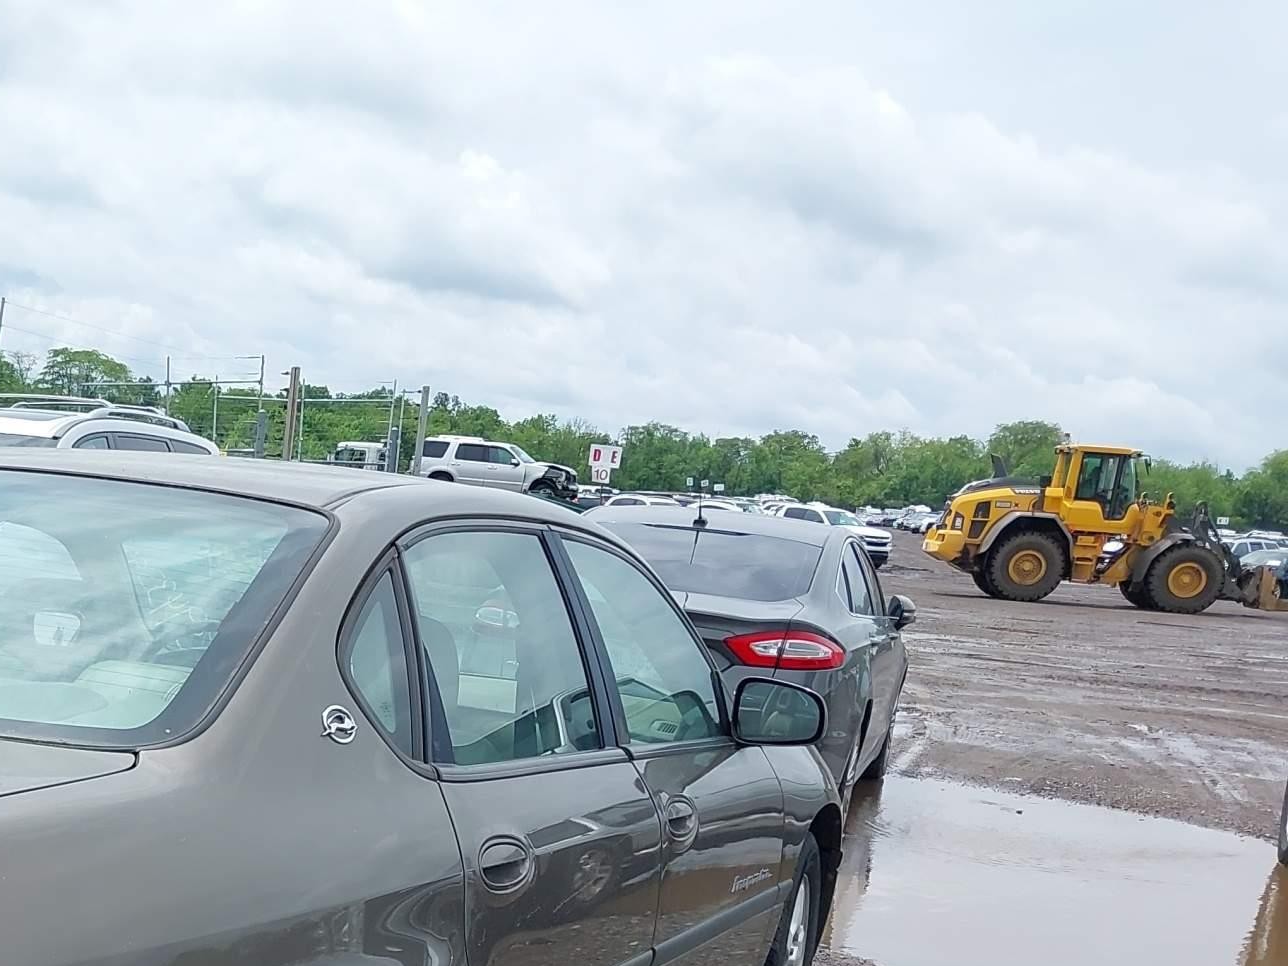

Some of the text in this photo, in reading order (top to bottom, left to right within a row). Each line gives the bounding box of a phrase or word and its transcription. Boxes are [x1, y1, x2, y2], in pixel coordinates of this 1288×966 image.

[593, 448, 618, 464] D E
[594, 468, 608, 481] 10
